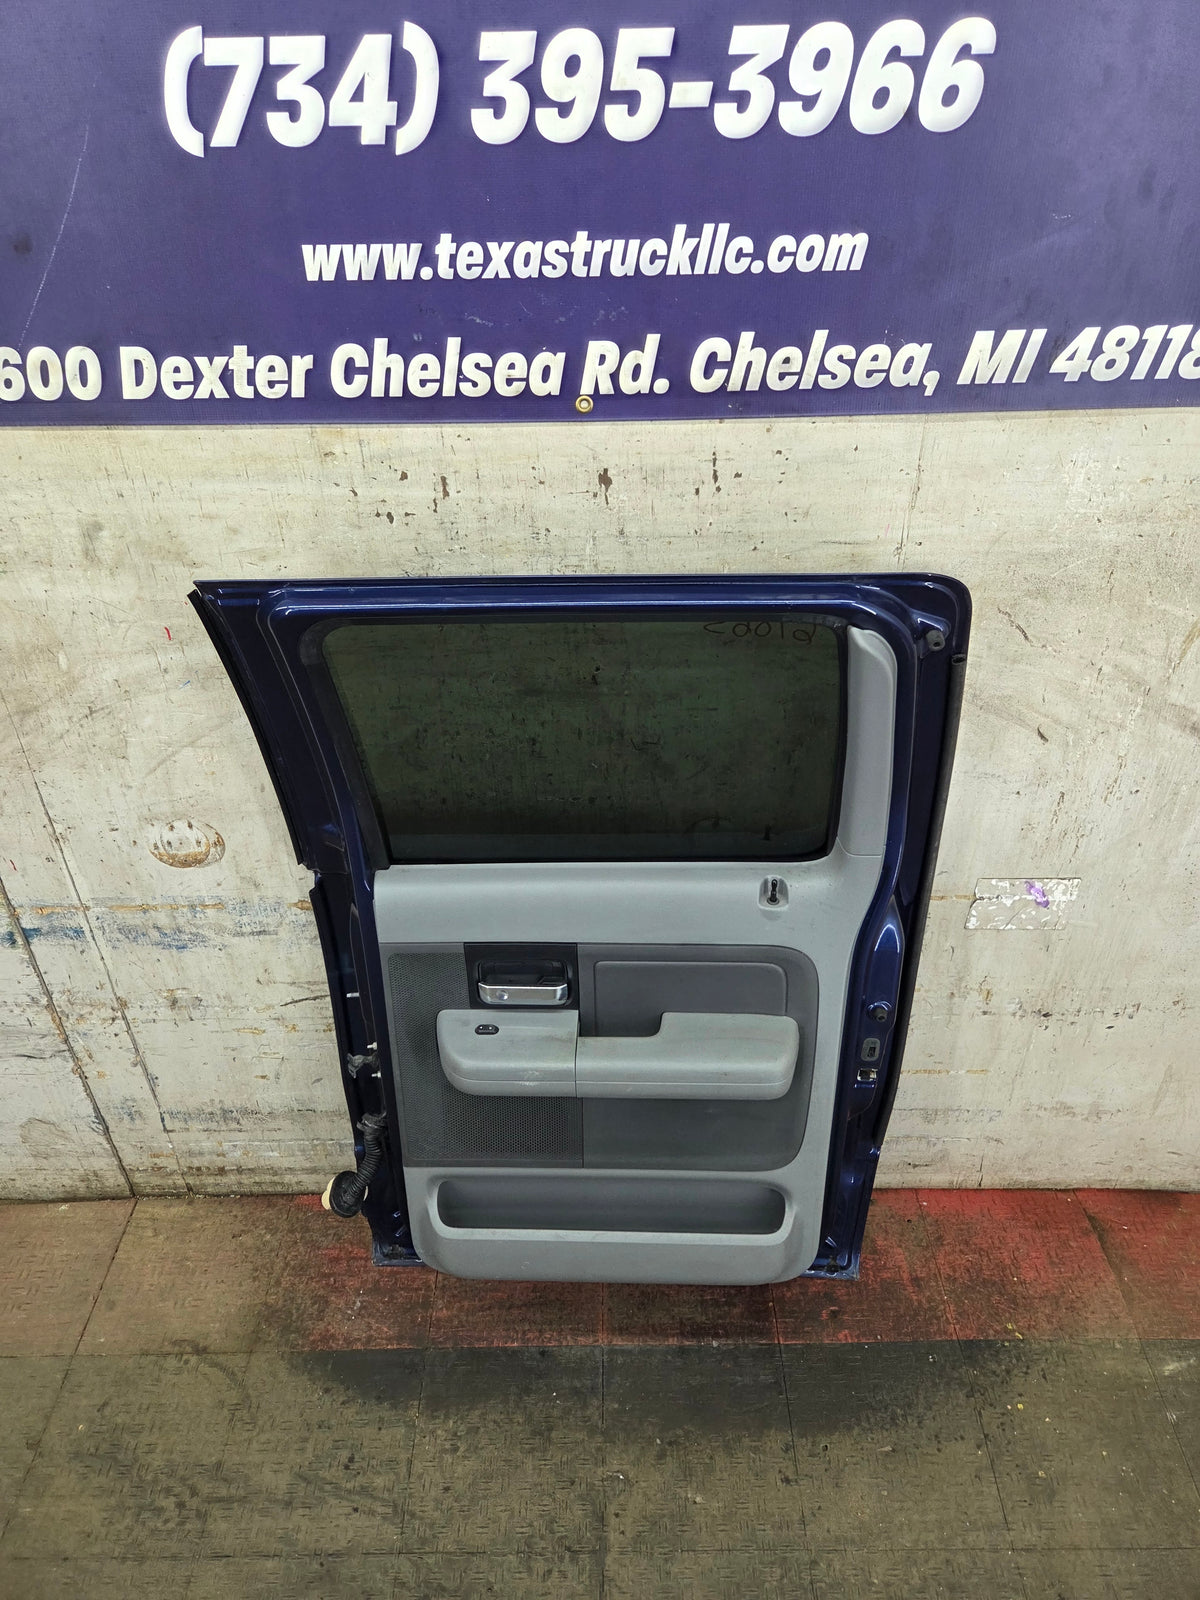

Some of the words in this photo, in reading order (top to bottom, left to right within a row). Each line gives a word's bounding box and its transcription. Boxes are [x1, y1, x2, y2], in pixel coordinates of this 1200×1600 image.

[163, 20, 440, 158] (734)
[470, 16, 997, 145] 395-3966
[301, 222, 869, 282] www.texastruckllc.com
[0, 345, 102, 402] 600
[119, 344, 314, 400] Dexter
[330, 336, 566, 399] Chelsea
[579, 333, 670, 396] Rd.
[689, 329, 940, 397] Chelsea,
[956, 328, 1048, 385] MI
